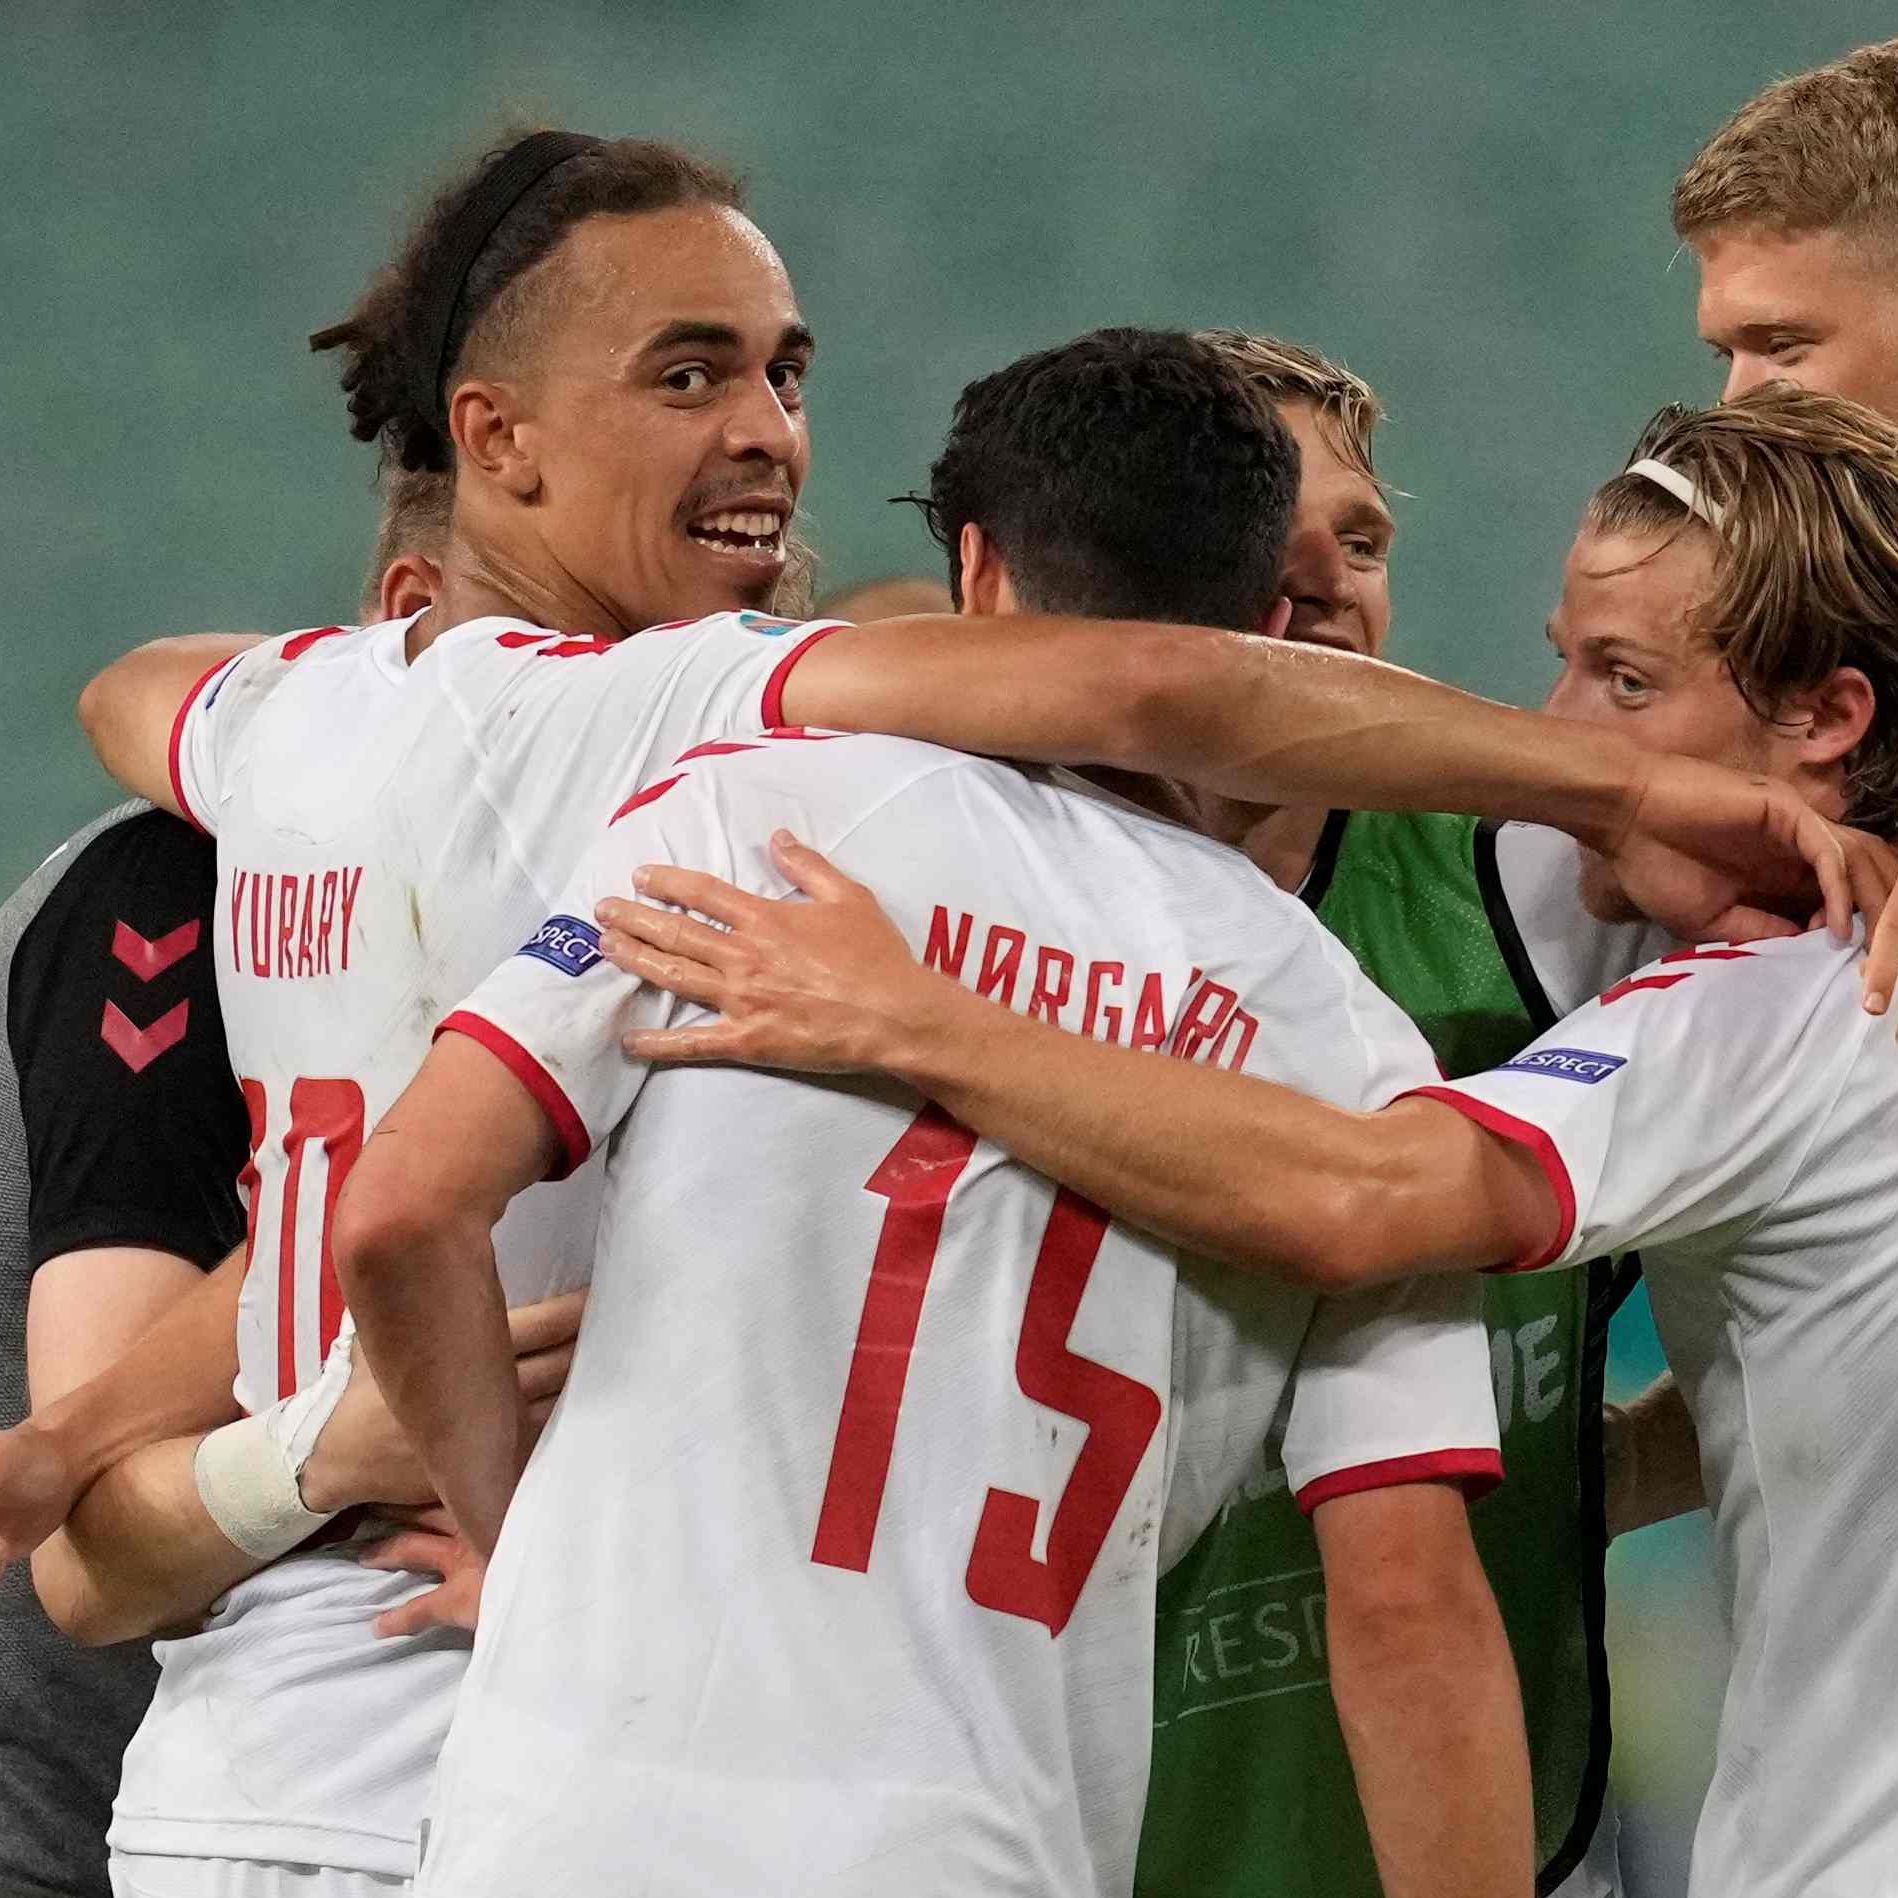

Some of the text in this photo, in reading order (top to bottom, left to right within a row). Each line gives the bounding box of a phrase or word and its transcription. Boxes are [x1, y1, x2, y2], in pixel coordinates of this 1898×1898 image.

[232, 866, 363, 978] YURARY
[530, 926, 604, 963] SPECT
[240, 1076, 366, 1400] 0
[811, 1103, 1161, 1638] 15
